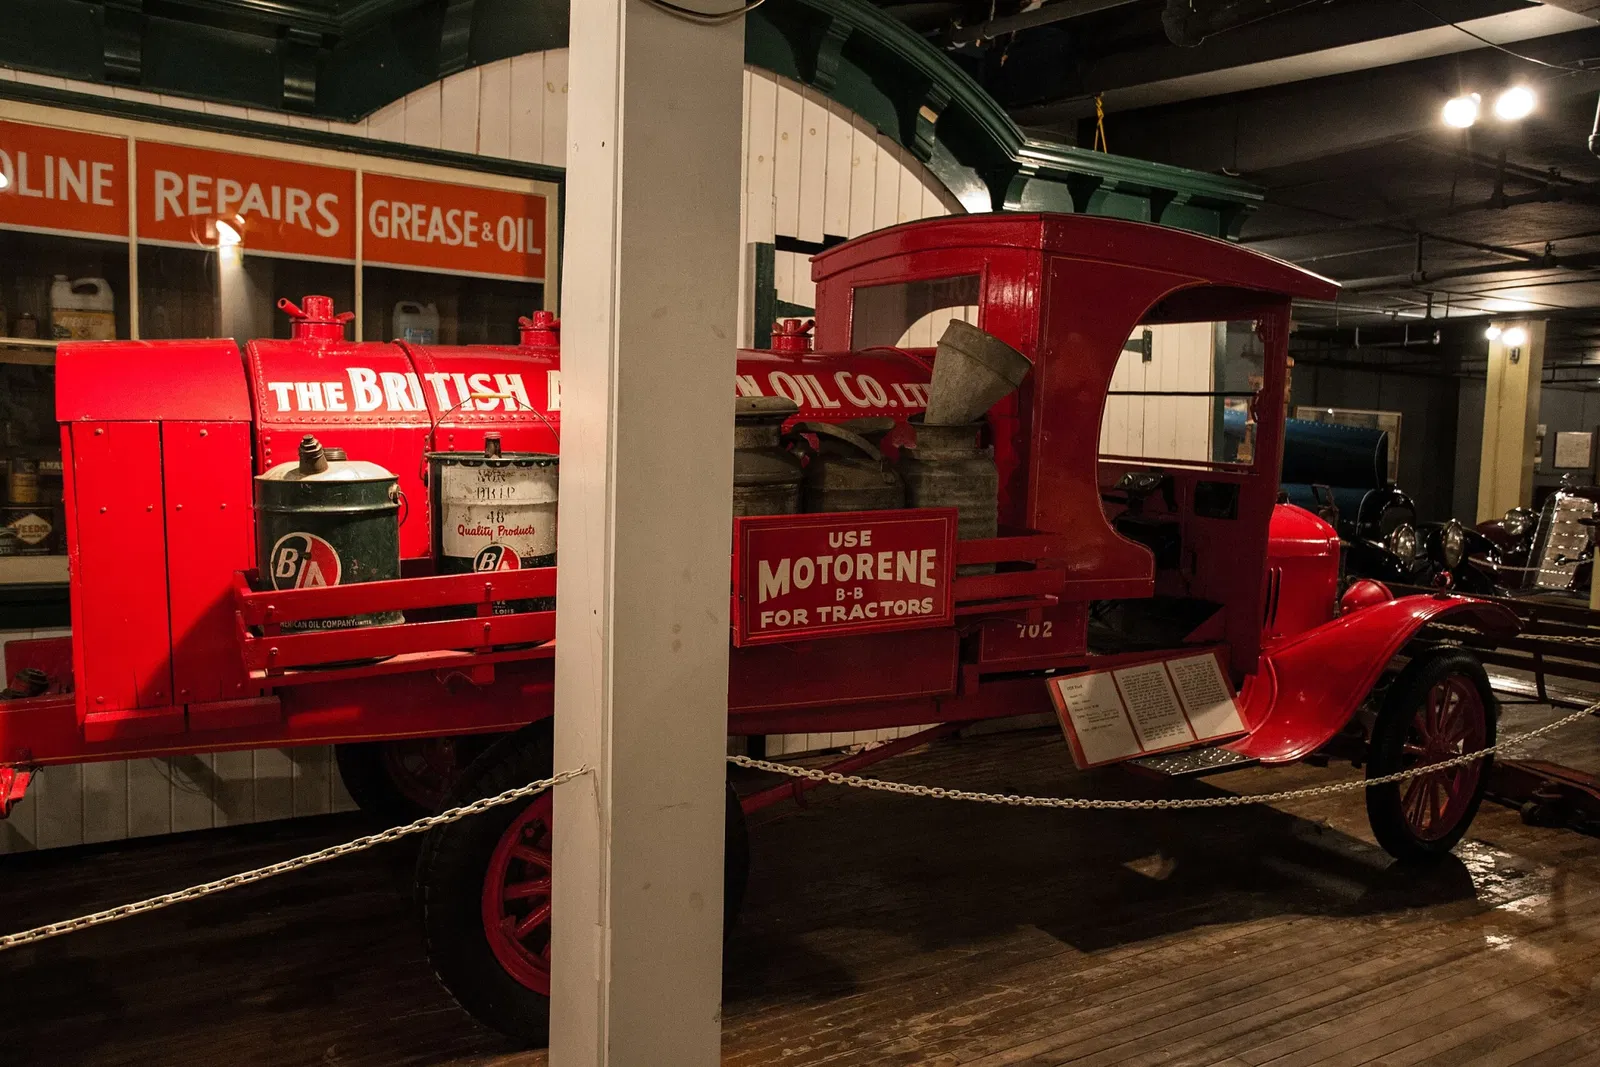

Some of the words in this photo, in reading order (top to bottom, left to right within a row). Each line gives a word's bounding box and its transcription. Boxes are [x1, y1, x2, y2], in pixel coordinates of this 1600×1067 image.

[154, 169, 340, 238] REPAIRS
[368, 200, 478, 248] GREASE
[481, 221, 494, 242] &
[497, 215, 542, 255] OIL
[268, 382, 345, 412] THE
[346, 367, 533, 412] BRITISH
[767, 371, 841, 409] OIL
[834, 371, 897, 408] CO.
[457, 524, 493, 540] Quality
[498, 525, 536, 536] Products
[829, 530, 872, 548] USE
[758, 548, 937, 604] MOTORENE
[836, 587, 864, 601] B-B
[322, 619, 355, 628] COMPANY
[760, 608, 809, 629] FOR
[816, 597, 934, 623] TRACTORS
[1016, 621, 1052, 638] 702
